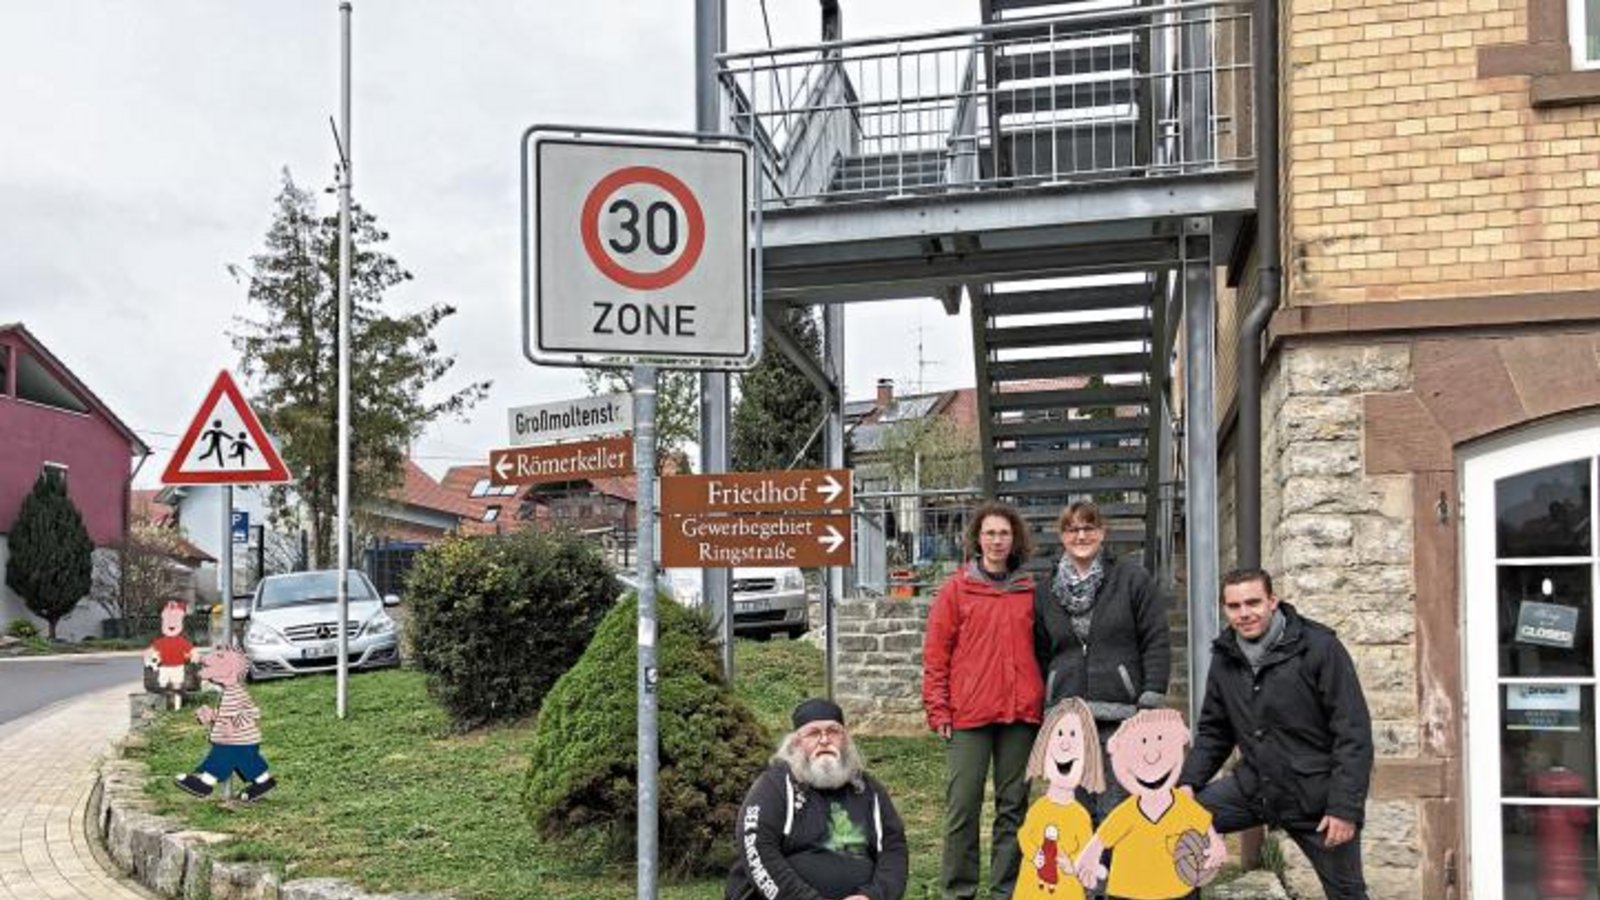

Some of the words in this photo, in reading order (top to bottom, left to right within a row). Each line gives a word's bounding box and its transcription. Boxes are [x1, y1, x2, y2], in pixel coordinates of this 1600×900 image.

[608, 199, 678, 256] 30
[592, 302, 697, 337] ZONE
[516, 447, 627, 476] Römerkeller
[707, 478, 812, 505] Friedhof
[232, 514, 242, 526] P
[681, 517, 813, 540] Gewerbegebiet
[699, 542, 797, 565] Ringstraße
[1521, 625, 1572, 641] CLOSED
